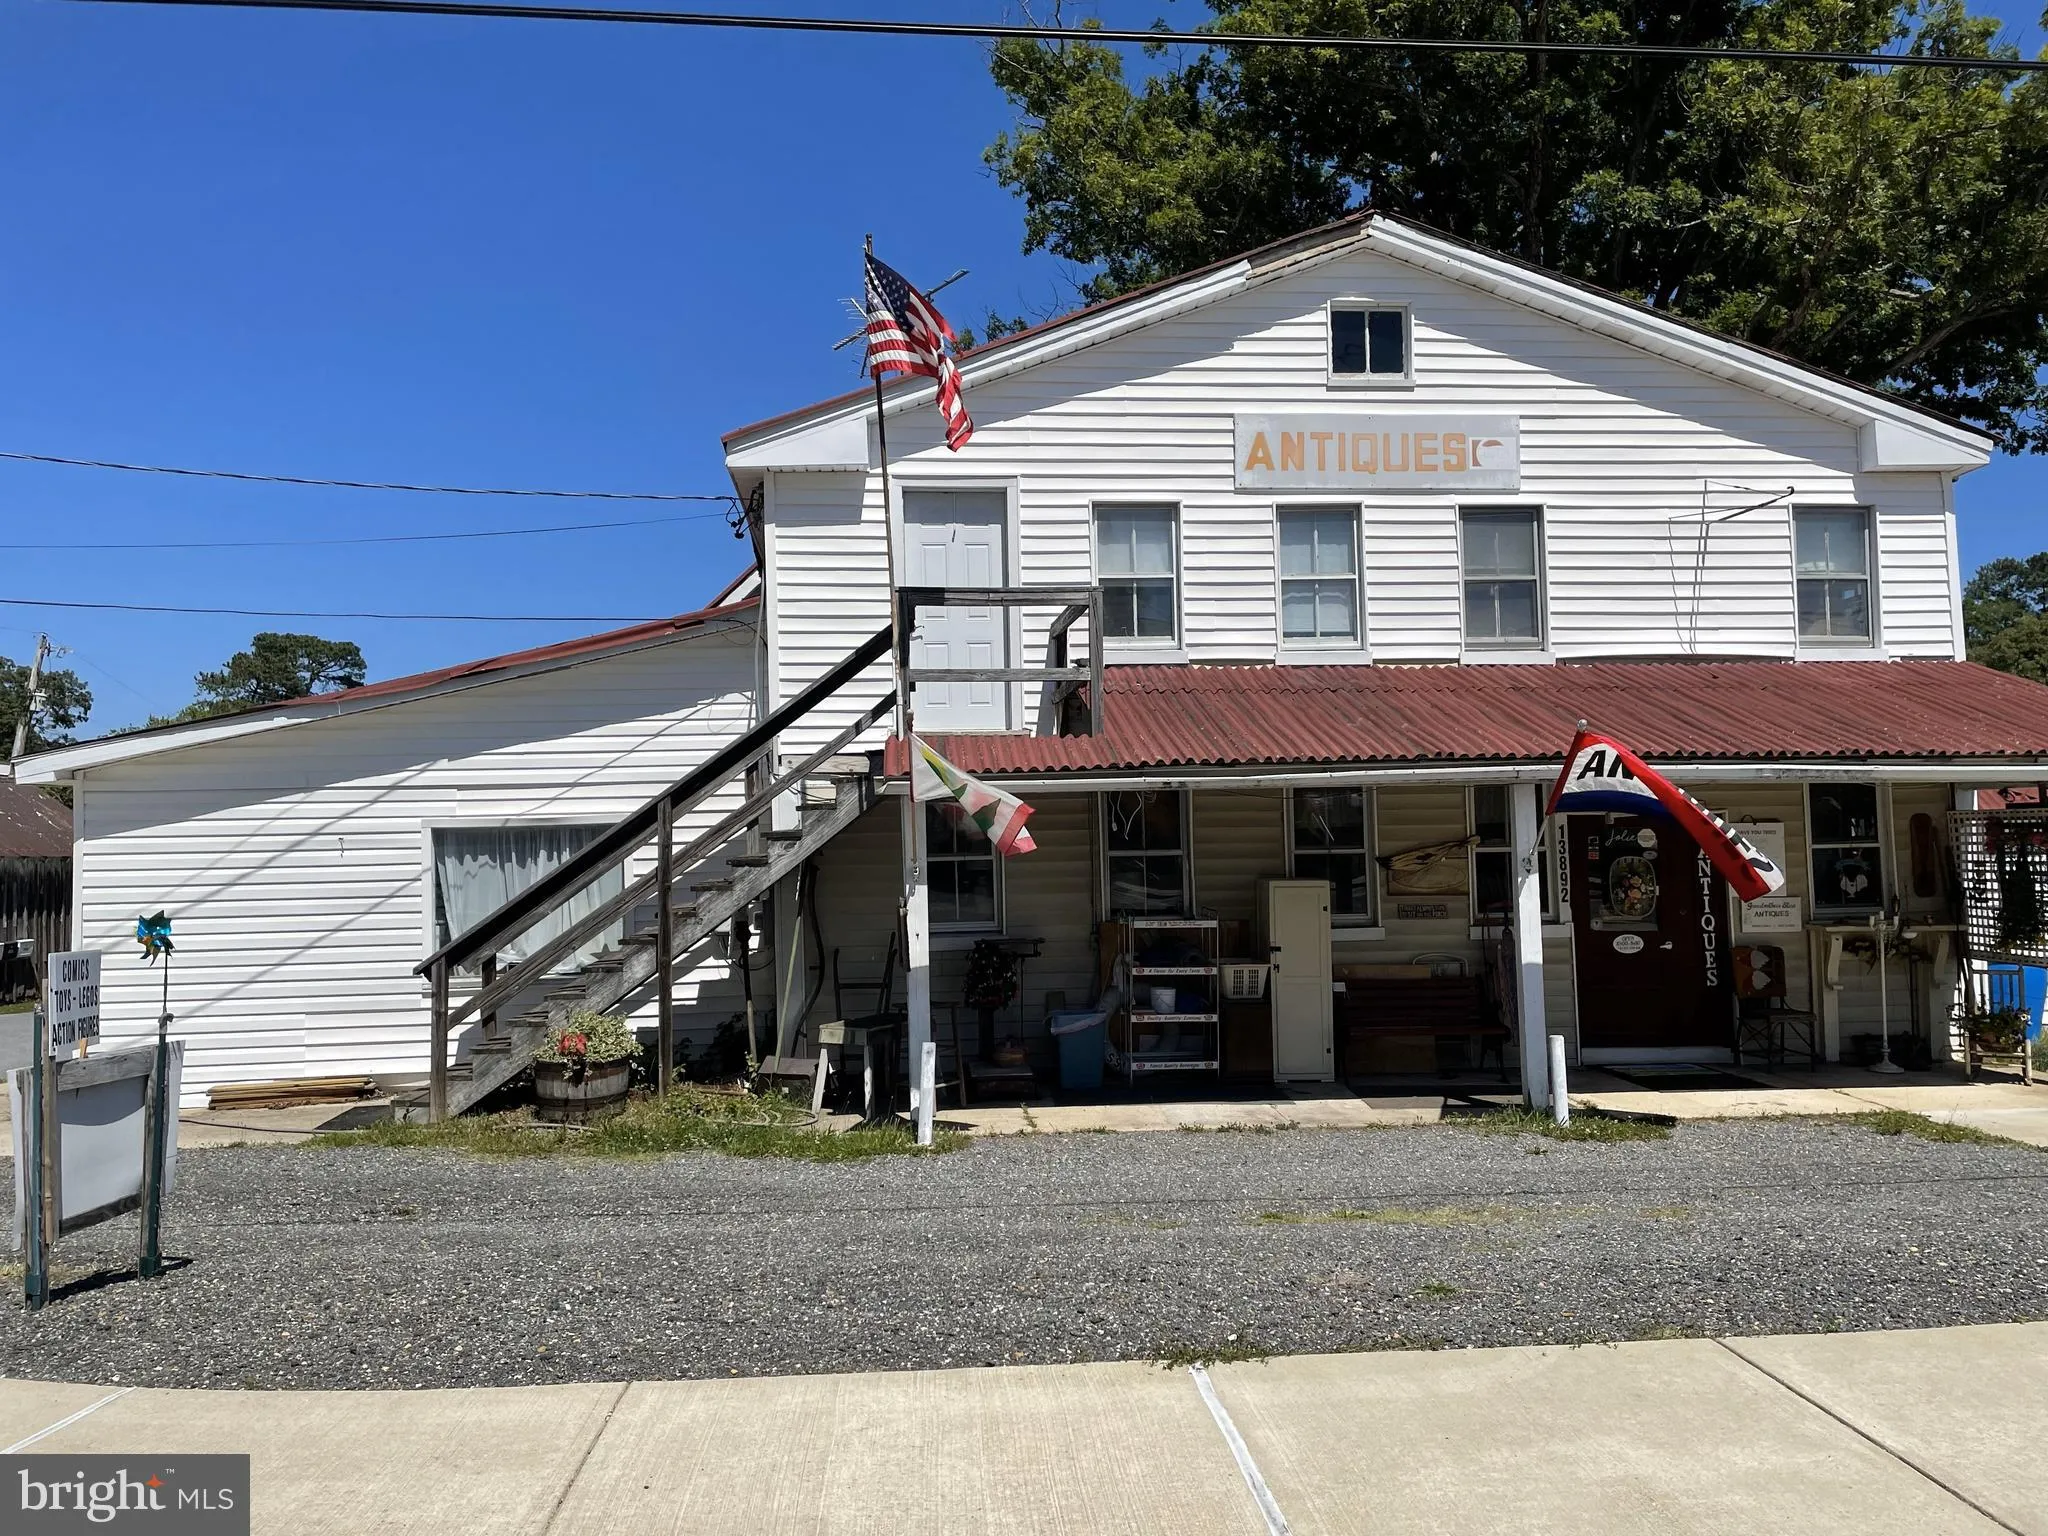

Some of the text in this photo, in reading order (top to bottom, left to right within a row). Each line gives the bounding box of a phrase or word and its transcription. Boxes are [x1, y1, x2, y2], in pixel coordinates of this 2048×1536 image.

[1245, 431, 1467, 474] ANTIQUES
[1558, 825, 1569, 903] 13892
[62, 958, 89, 982] COMICS
[54, 988, 71, 1012] TOYS
[78, 985, 98, 1008] LEGOS
[52, 1015, 100, 1046] ACTION FIGURES
